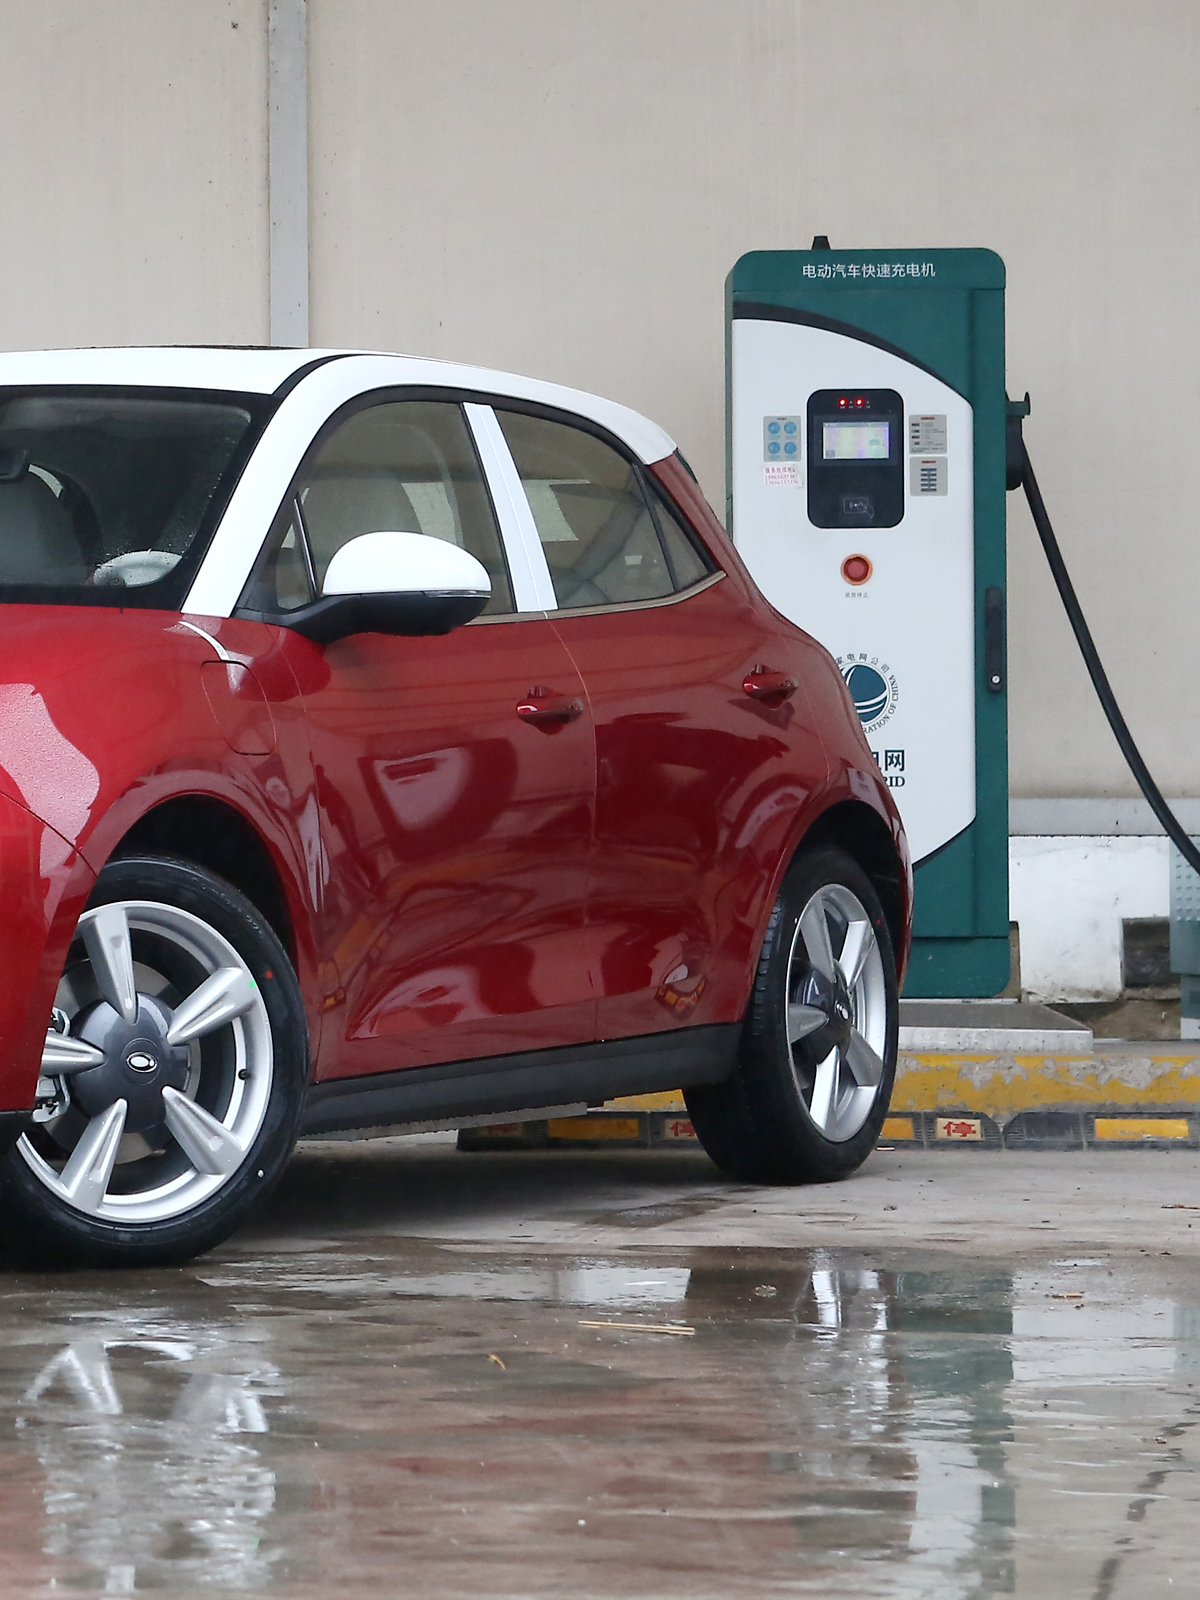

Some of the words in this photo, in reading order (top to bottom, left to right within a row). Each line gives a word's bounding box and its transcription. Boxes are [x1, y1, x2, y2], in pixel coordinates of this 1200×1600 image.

[802, 263, 936, 279] 电动汽车快速充电机
[888, 674, 899, 702] CHINA
[887, 702, 897, 715] OF
[943, 1121, 976, 1137] 停
